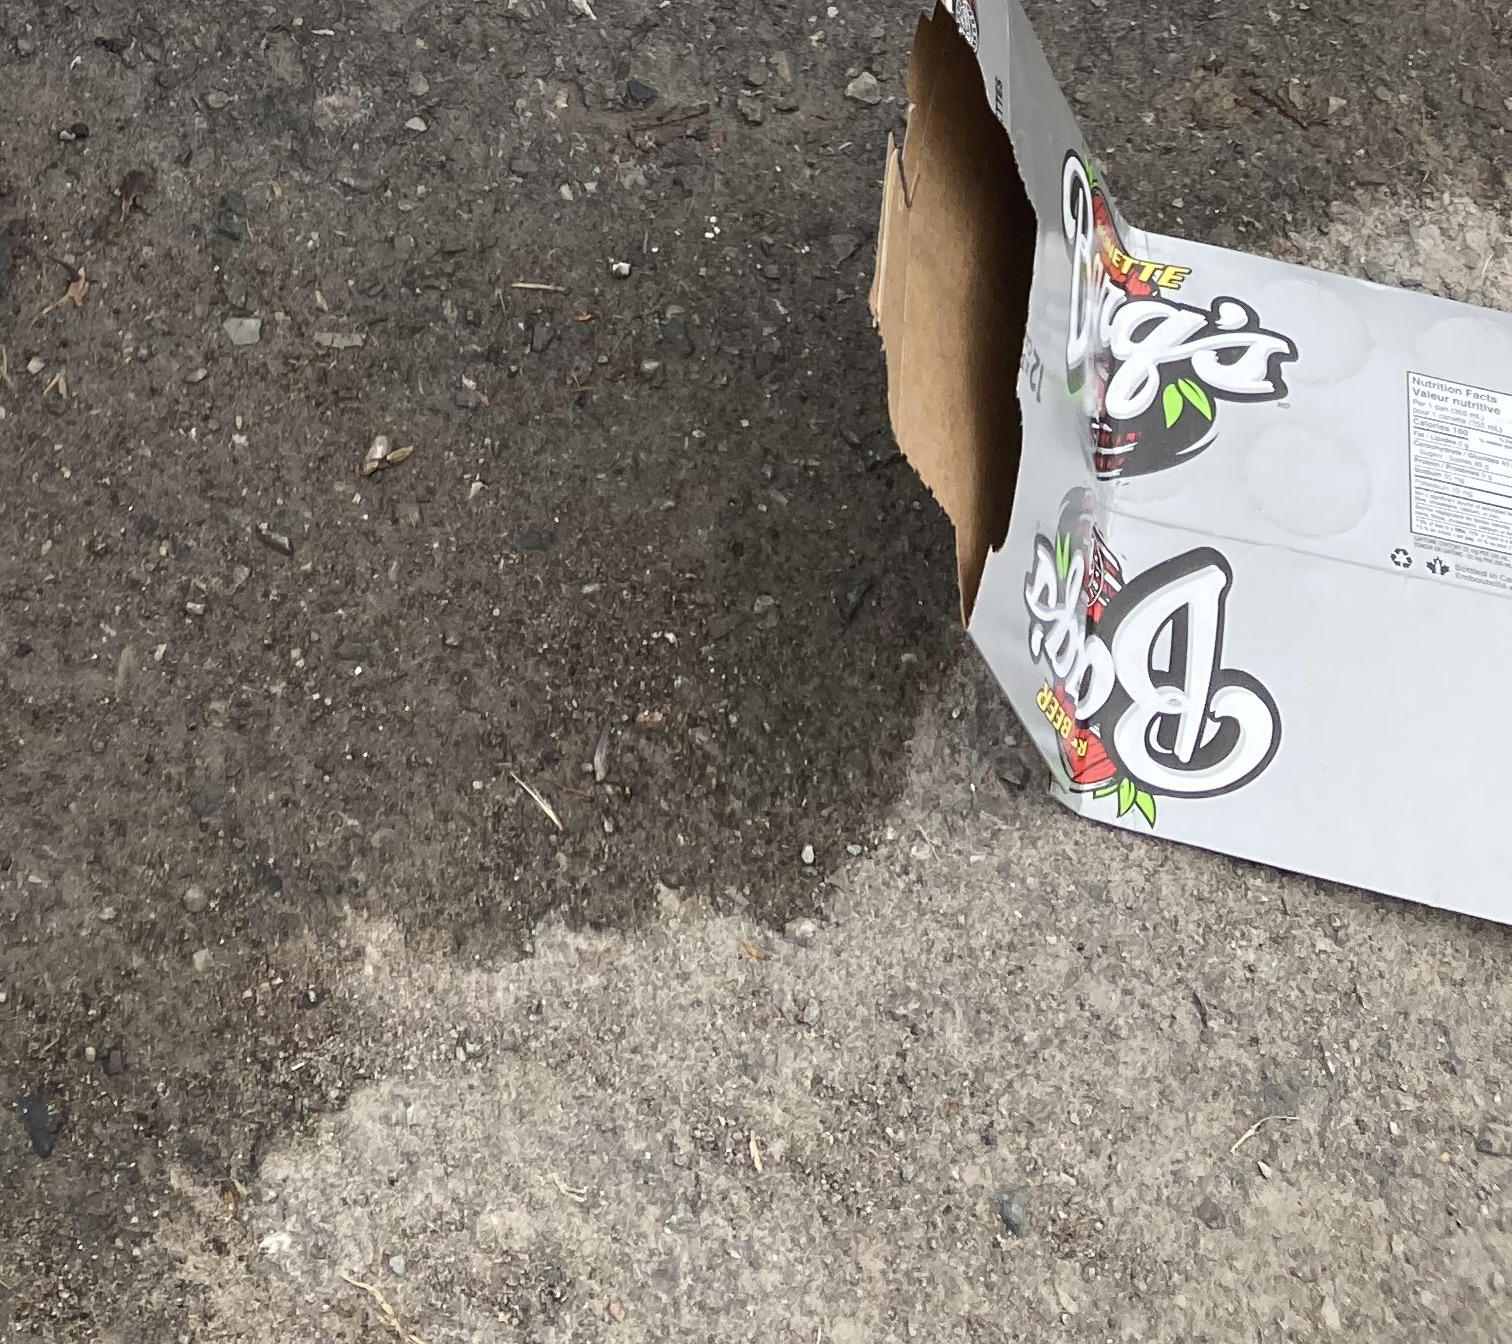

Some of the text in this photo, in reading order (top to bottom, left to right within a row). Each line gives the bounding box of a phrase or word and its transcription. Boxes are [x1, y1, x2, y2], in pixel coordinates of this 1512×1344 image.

[1411, 376, 1498, 404] Nutrition Facts
[1411, 387, 1501, 416] Valeur nutritive
[1412, 418, 1450, 432] Calories
[1037, 681, 1072, 739] BEER
